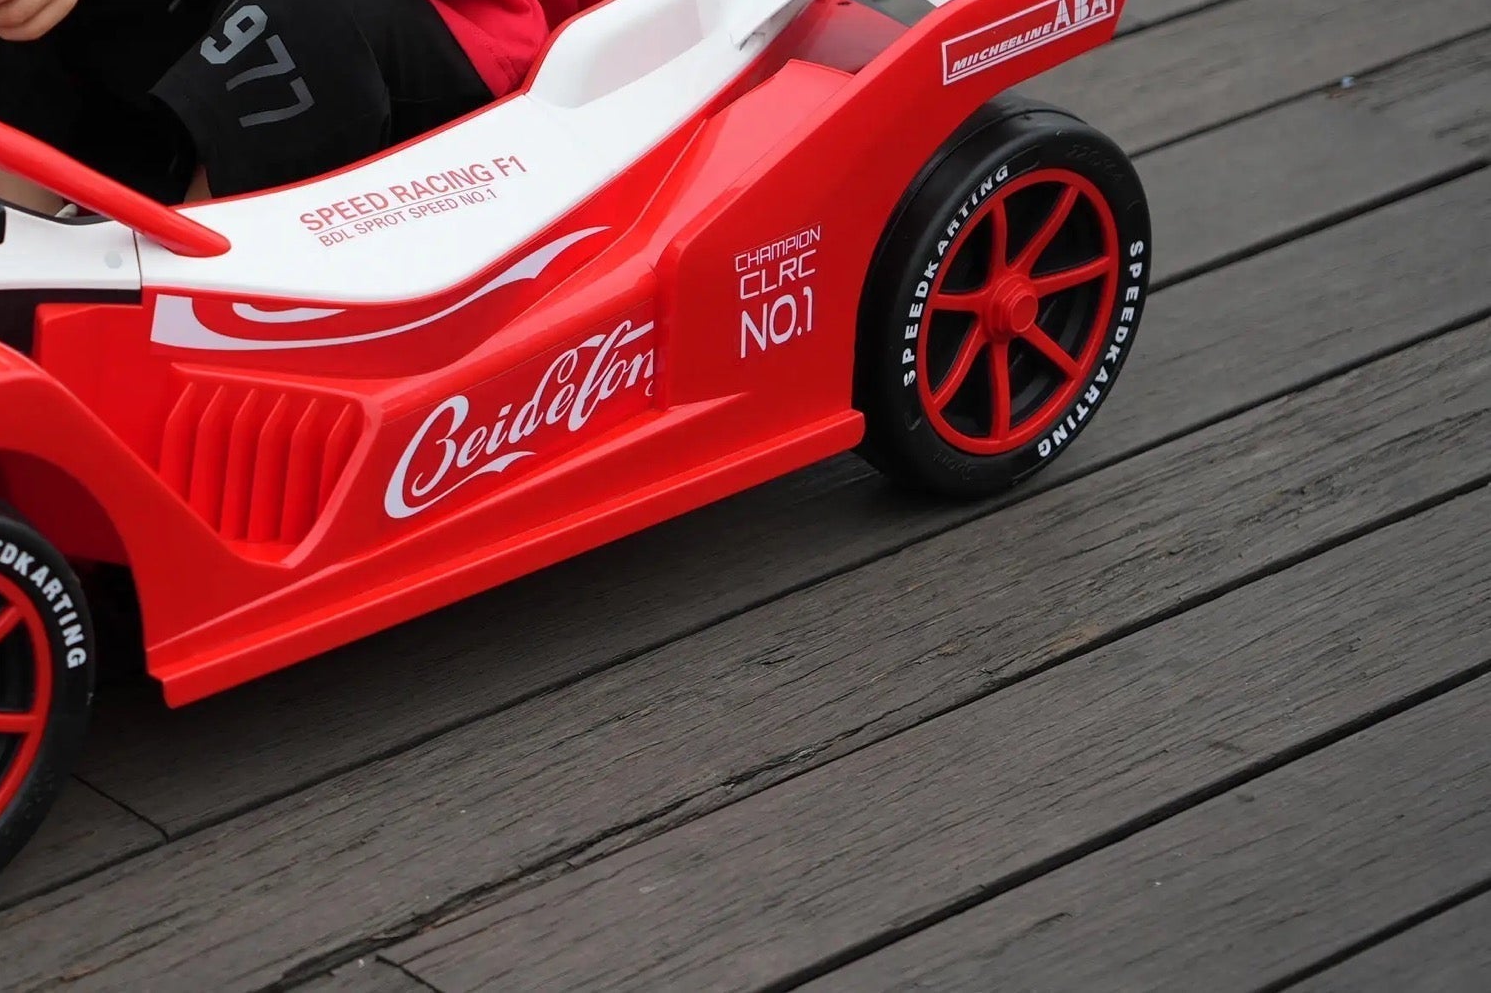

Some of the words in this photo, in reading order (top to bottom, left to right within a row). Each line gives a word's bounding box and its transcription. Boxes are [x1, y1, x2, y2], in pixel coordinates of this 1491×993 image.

[300, 192, 390, 231] SPEED
[389, 163, 495, 203] RACING
[493, 155, 527, 179] F1
[319, 228, 354, 247] BDL
[354, 212, 406, 235] SPROT
[409, 198, 458, 219] SPEED
[462, 188, 498, 205] NO.1
[735, 225, 821, 272] CHAMPION
[740, 249, 816, 299] CLRC
[902, 164, 1009, 387] SPEEDKARTING
[740, 286, 813, 358] NO.1
[1038, 239, 1144, 458] SPEEDKARTING
